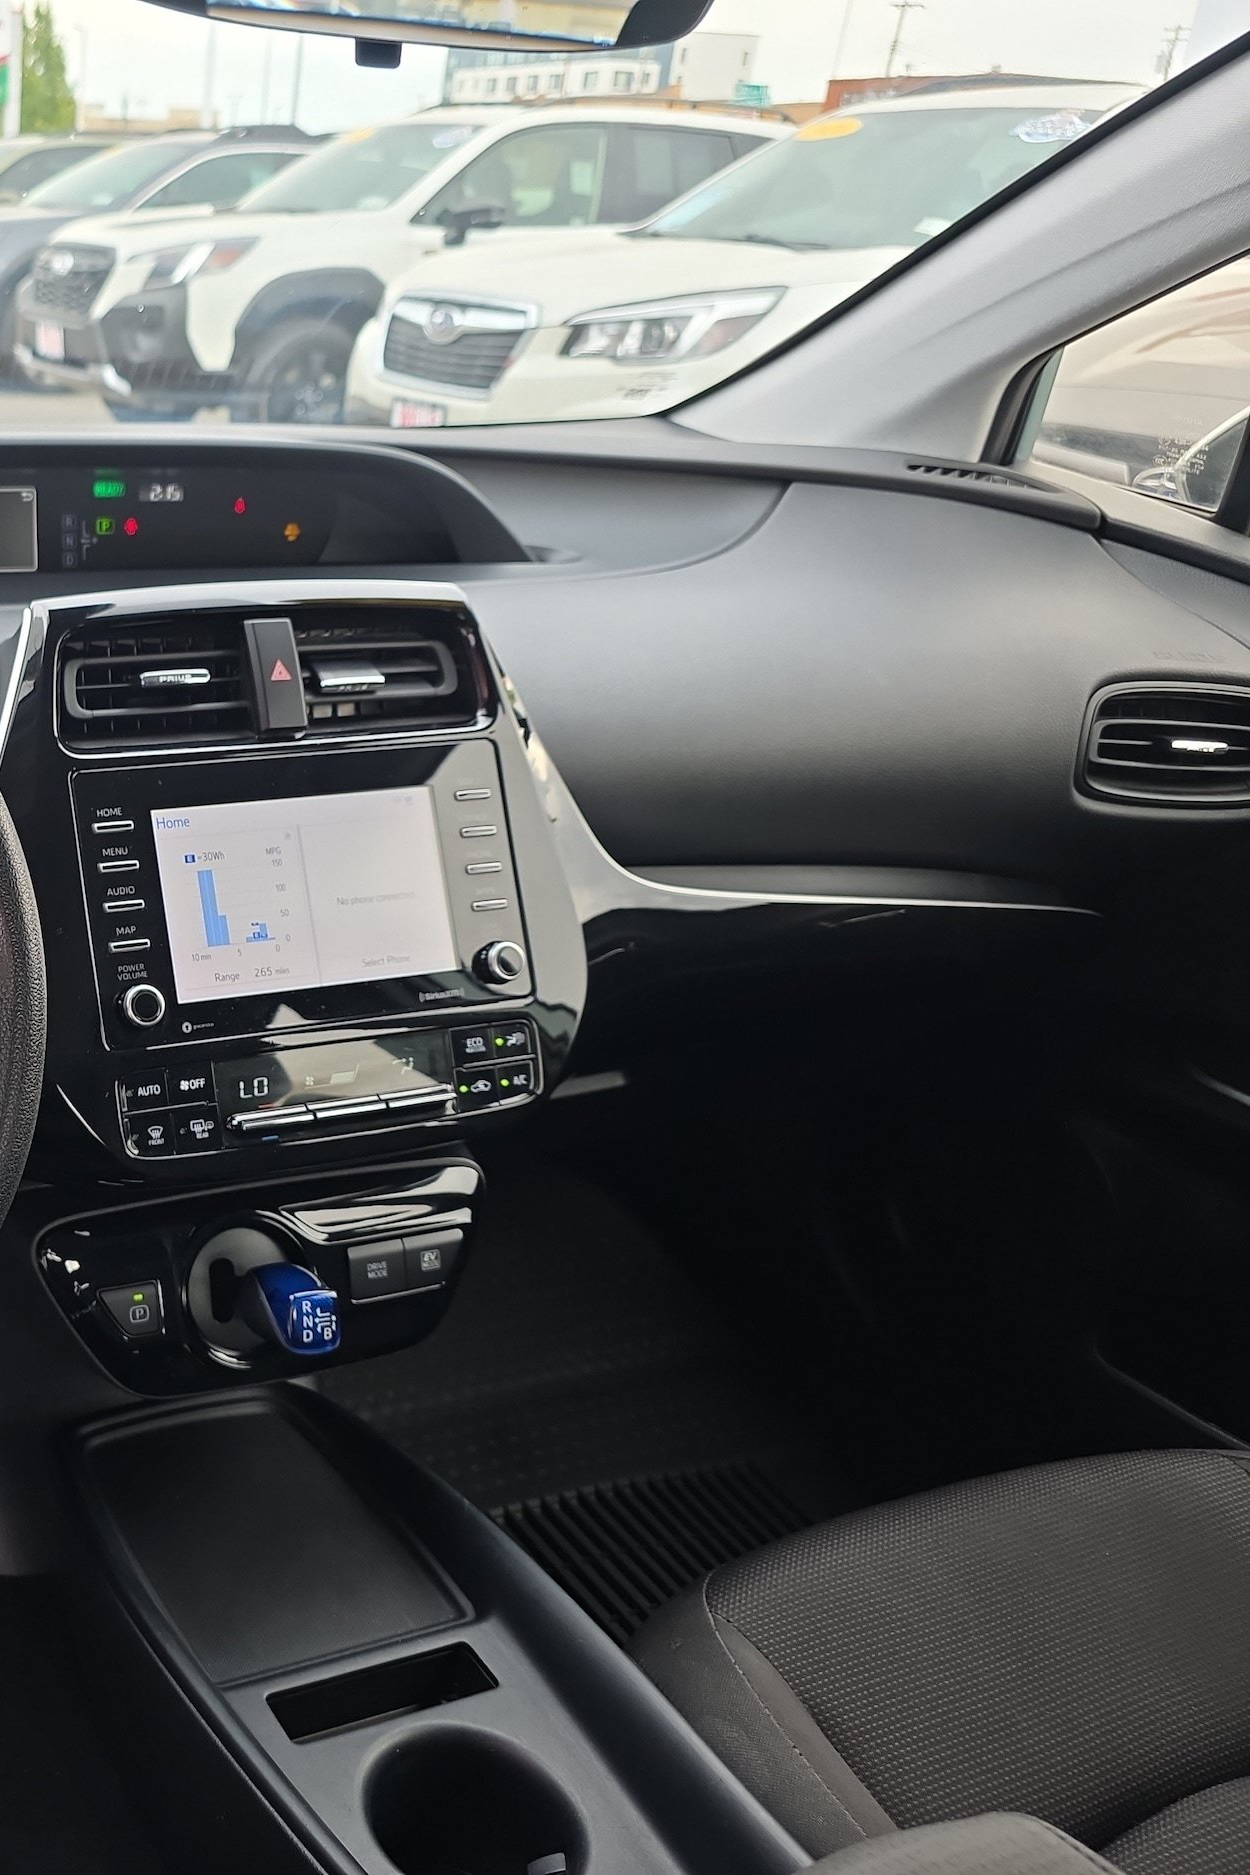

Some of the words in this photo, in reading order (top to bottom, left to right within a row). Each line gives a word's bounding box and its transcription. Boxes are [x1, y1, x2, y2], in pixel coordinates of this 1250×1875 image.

[96, 807, 123, 818] HOME
[156, 817, 190, 830] Home
[102, 847, 128, 857] MENU
[266, 846, 281, 856] MPG
[272, 859, 283, 867] 150
[107, 886, 136, 896] AUDIO
[276, 884, 286, 892] 100
[280, 909, 290, 917] 50
[116, 926, 136, 936] MAP
[191, 953, 199, 962] 10
[118, 963, 145, 972] POWER
[117, 971, 148, 981] VOLUME
[215, 972, 240, 983] Range
[255, 967, 273, 978] 265
[466, 1036, 484, 1048] ECO
[190, 1078, 206, 1090] OFF
[137, 1085, 161, 1097] AUTO
[148, 1137, 165, 1146] FRONT
[423, 1251, 437, 1261] EV
[367, 1261, 387, 1271] DRIVE
[367, 1269, 388, 1279] MODE
[302, 1300, 313, 1314] R
[303, 1314, 314, 1329] N
[303, 1329, 314, 1343] D
[323, 1327, 333, 1341] B
